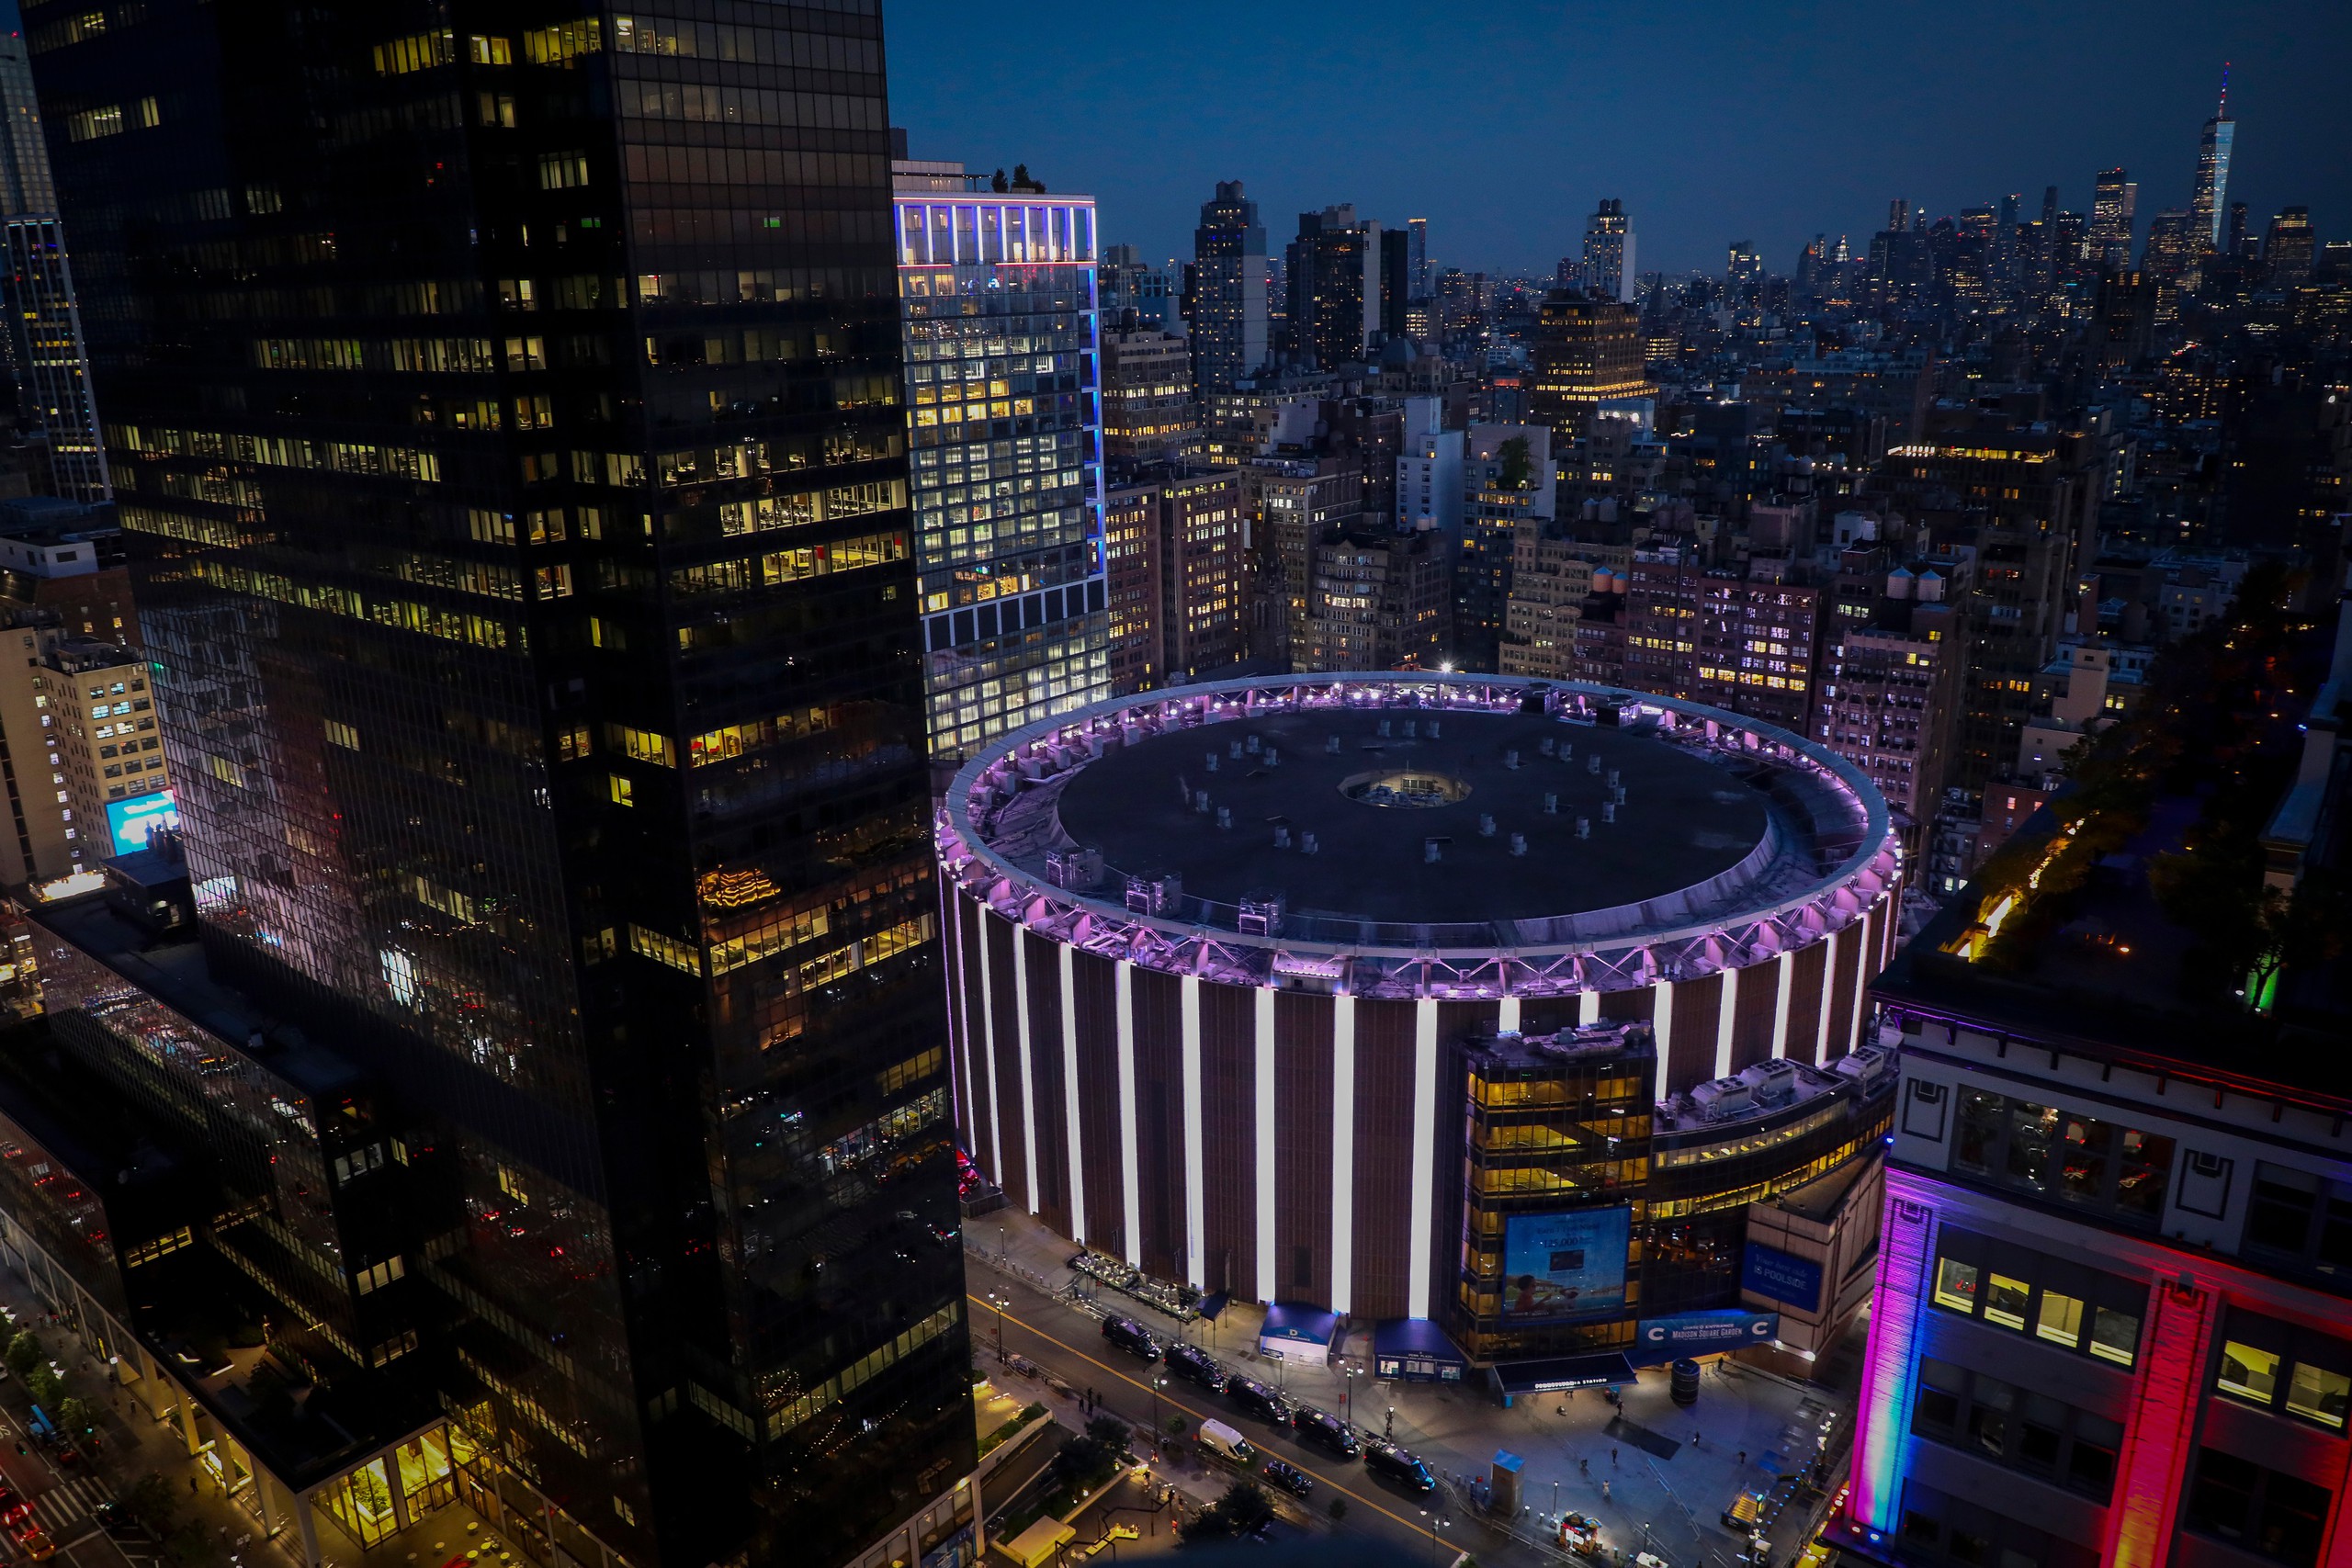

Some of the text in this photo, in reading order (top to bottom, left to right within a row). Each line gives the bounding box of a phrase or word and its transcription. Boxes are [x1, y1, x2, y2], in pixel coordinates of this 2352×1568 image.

[1544, 1237, 1578, 1248] 125,000
[1289, 1328, 1298, 1337] D
[1647, 1327, 1665, 1341] C
[1672, 1329, 1698, 1338] MADISON
[1698, 1328, 1720, 1337] SQUARE
[1720, 1327, 1743, 1337] GARDEN
[1751, 1321, 1769, 1336] C
